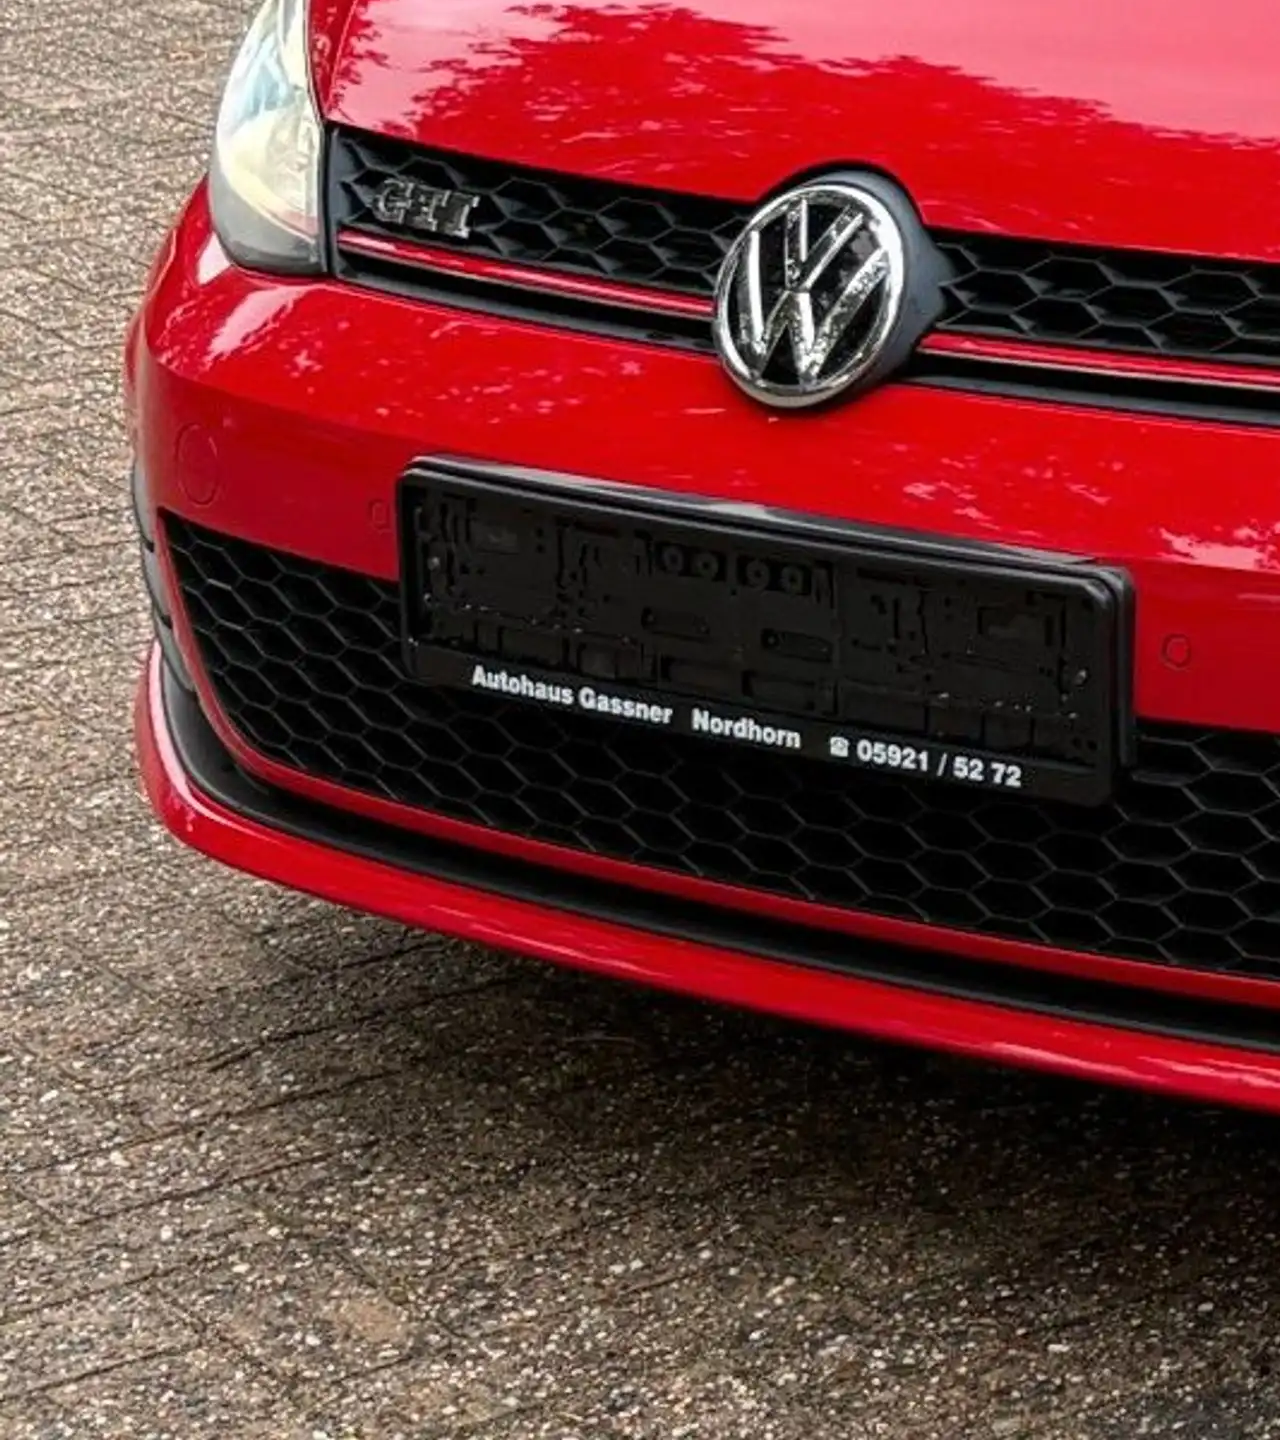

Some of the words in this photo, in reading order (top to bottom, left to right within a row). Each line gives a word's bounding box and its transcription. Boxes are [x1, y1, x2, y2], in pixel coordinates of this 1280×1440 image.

[375, 176, 480, 239] GTI
[470, 664, 575, 705] Autohaus
[578, 686, 674, 725] Gassner
[691, 708, 801, 749] Nordhorn
[856, 738, 929, 772] 05921
[953, 755, 984, 782] 52
[991, 762, 1022, 788] 72
